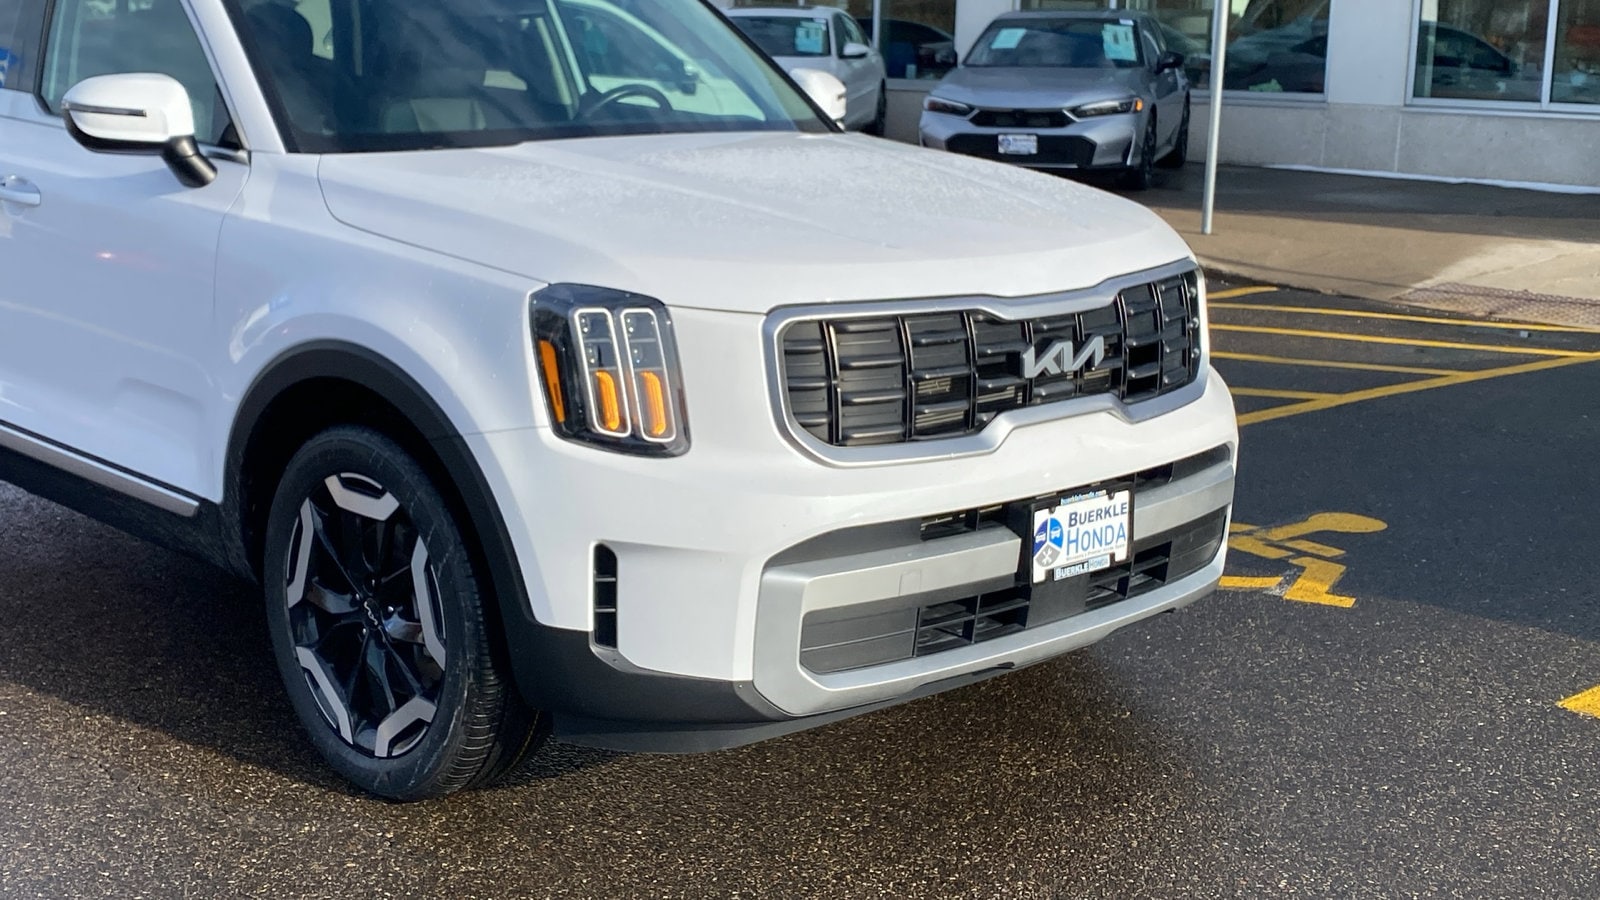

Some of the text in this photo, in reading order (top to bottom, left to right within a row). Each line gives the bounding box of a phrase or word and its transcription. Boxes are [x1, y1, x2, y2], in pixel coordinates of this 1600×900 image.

[1022, 335, 1105, 379] KIA
[1068, 502, 1128, 528] BUERKLE
[1066, 521, 1127, 556] HONDA
